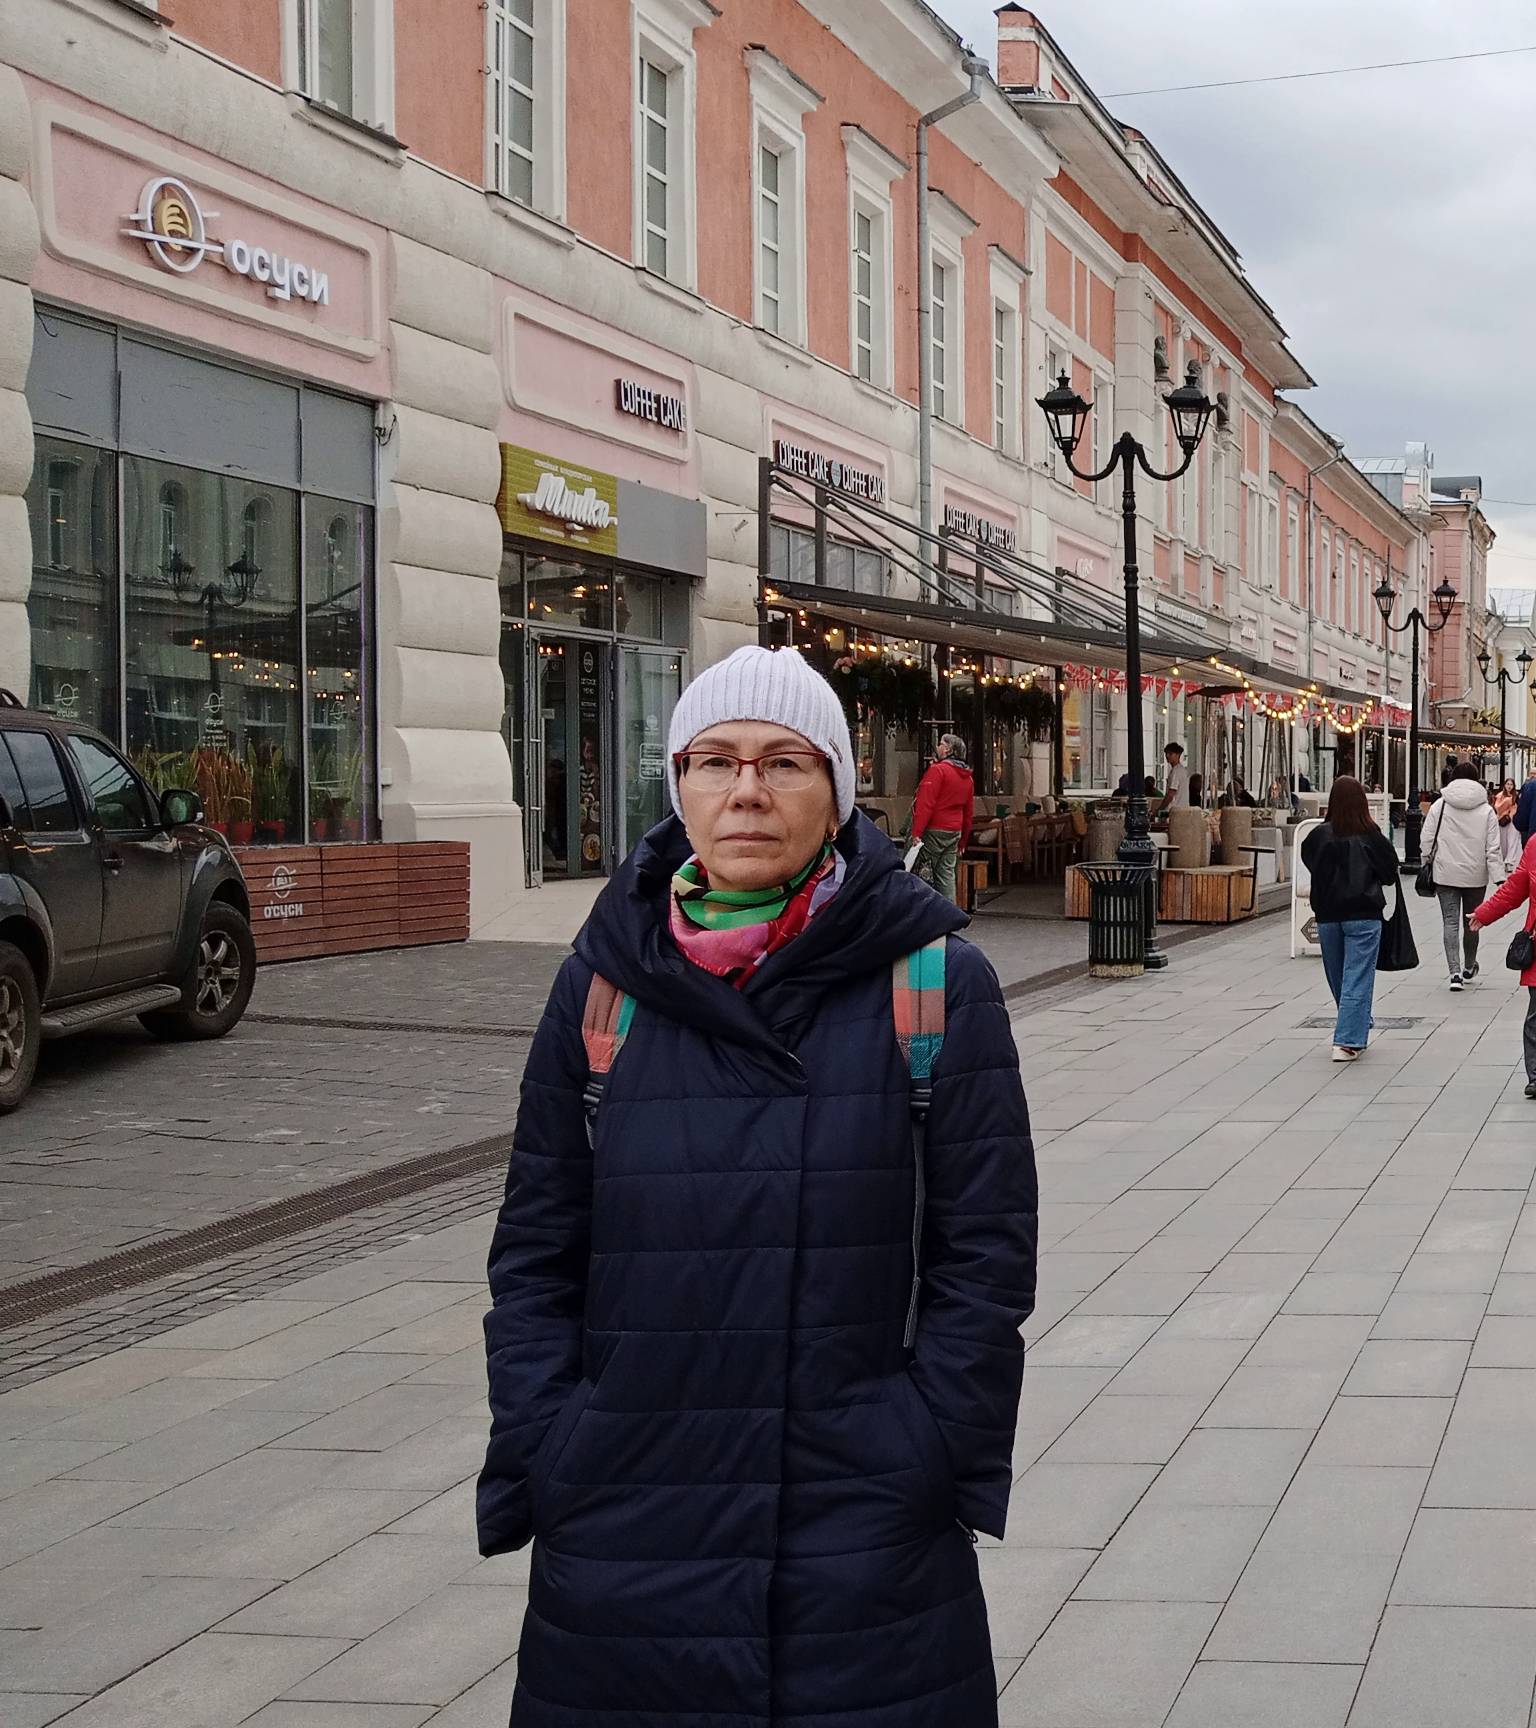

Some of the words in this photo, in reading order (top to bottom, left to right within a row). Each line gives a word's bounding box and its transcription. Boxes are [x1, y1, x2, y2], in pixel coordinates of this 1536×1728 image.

[229, 239, 329, 305] осуси
[620, 379, 658, 421] COFFEE
[660, 394, 686, 432] CAKE
[779, 440, 807, 476] COFFEE
[808, 450, 829, 484] CAKE
[842, 463, 867, 497] COFFEE
[946, 504, 965, 535] COFFEE
[965, 511, 979, 539] CAKE
[988, 523, 1004, 549] COFFEE
